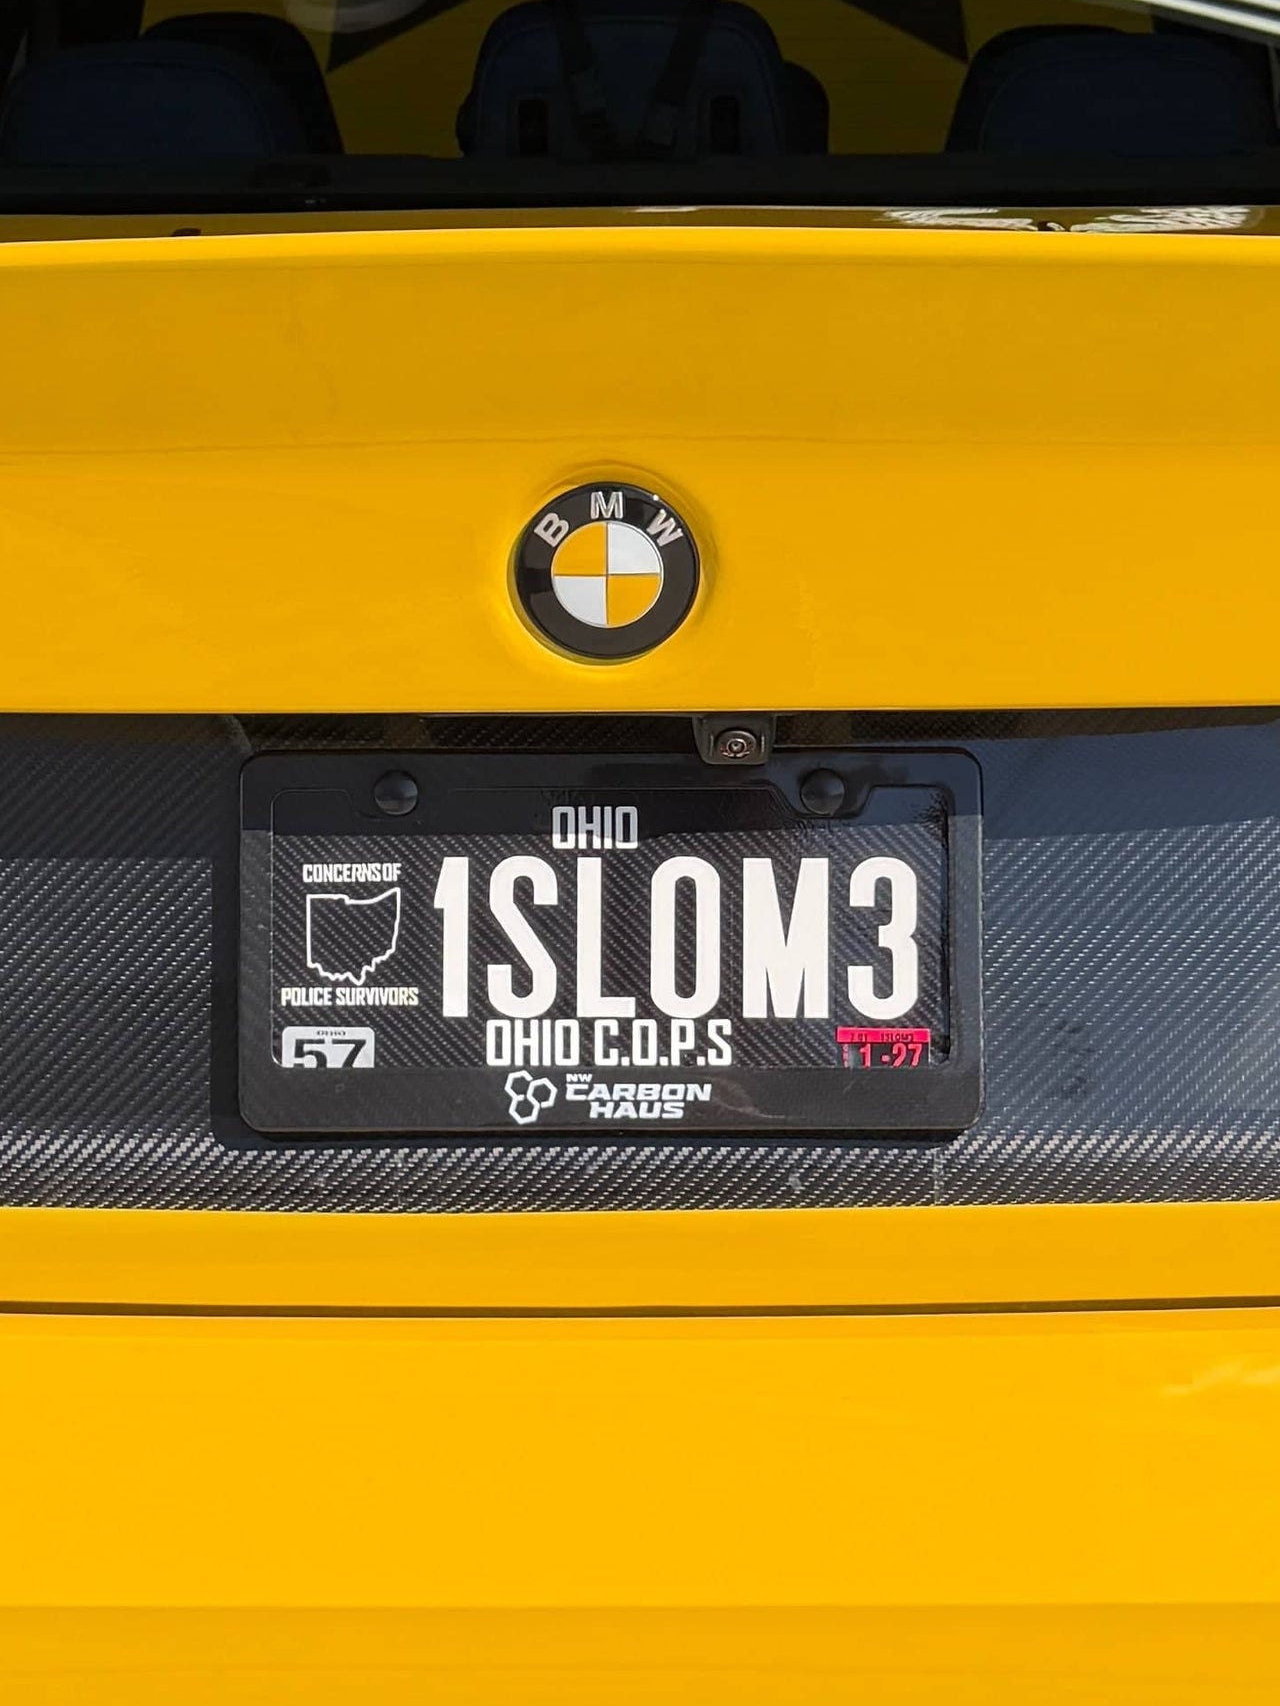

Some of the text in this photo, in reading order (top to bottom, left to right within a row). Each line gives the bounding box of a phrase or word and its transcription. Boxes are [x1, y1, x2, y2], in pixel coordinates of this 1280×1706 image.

[534, 491, 684, 547] BMW
[552, 806, 638, 849] OHIO
[433, 855, 918, 1019] 1SLOM3
[281, 987, 419, 1006] POLICE SURVIVORS
[486, 1019, 732, 1067] OHIO C.O.P.S
[565, 1083, 712, 1101] CARBON
[566, 1073, 593, 1083] NW
[589, 1101, 685, 1119] HAUS
